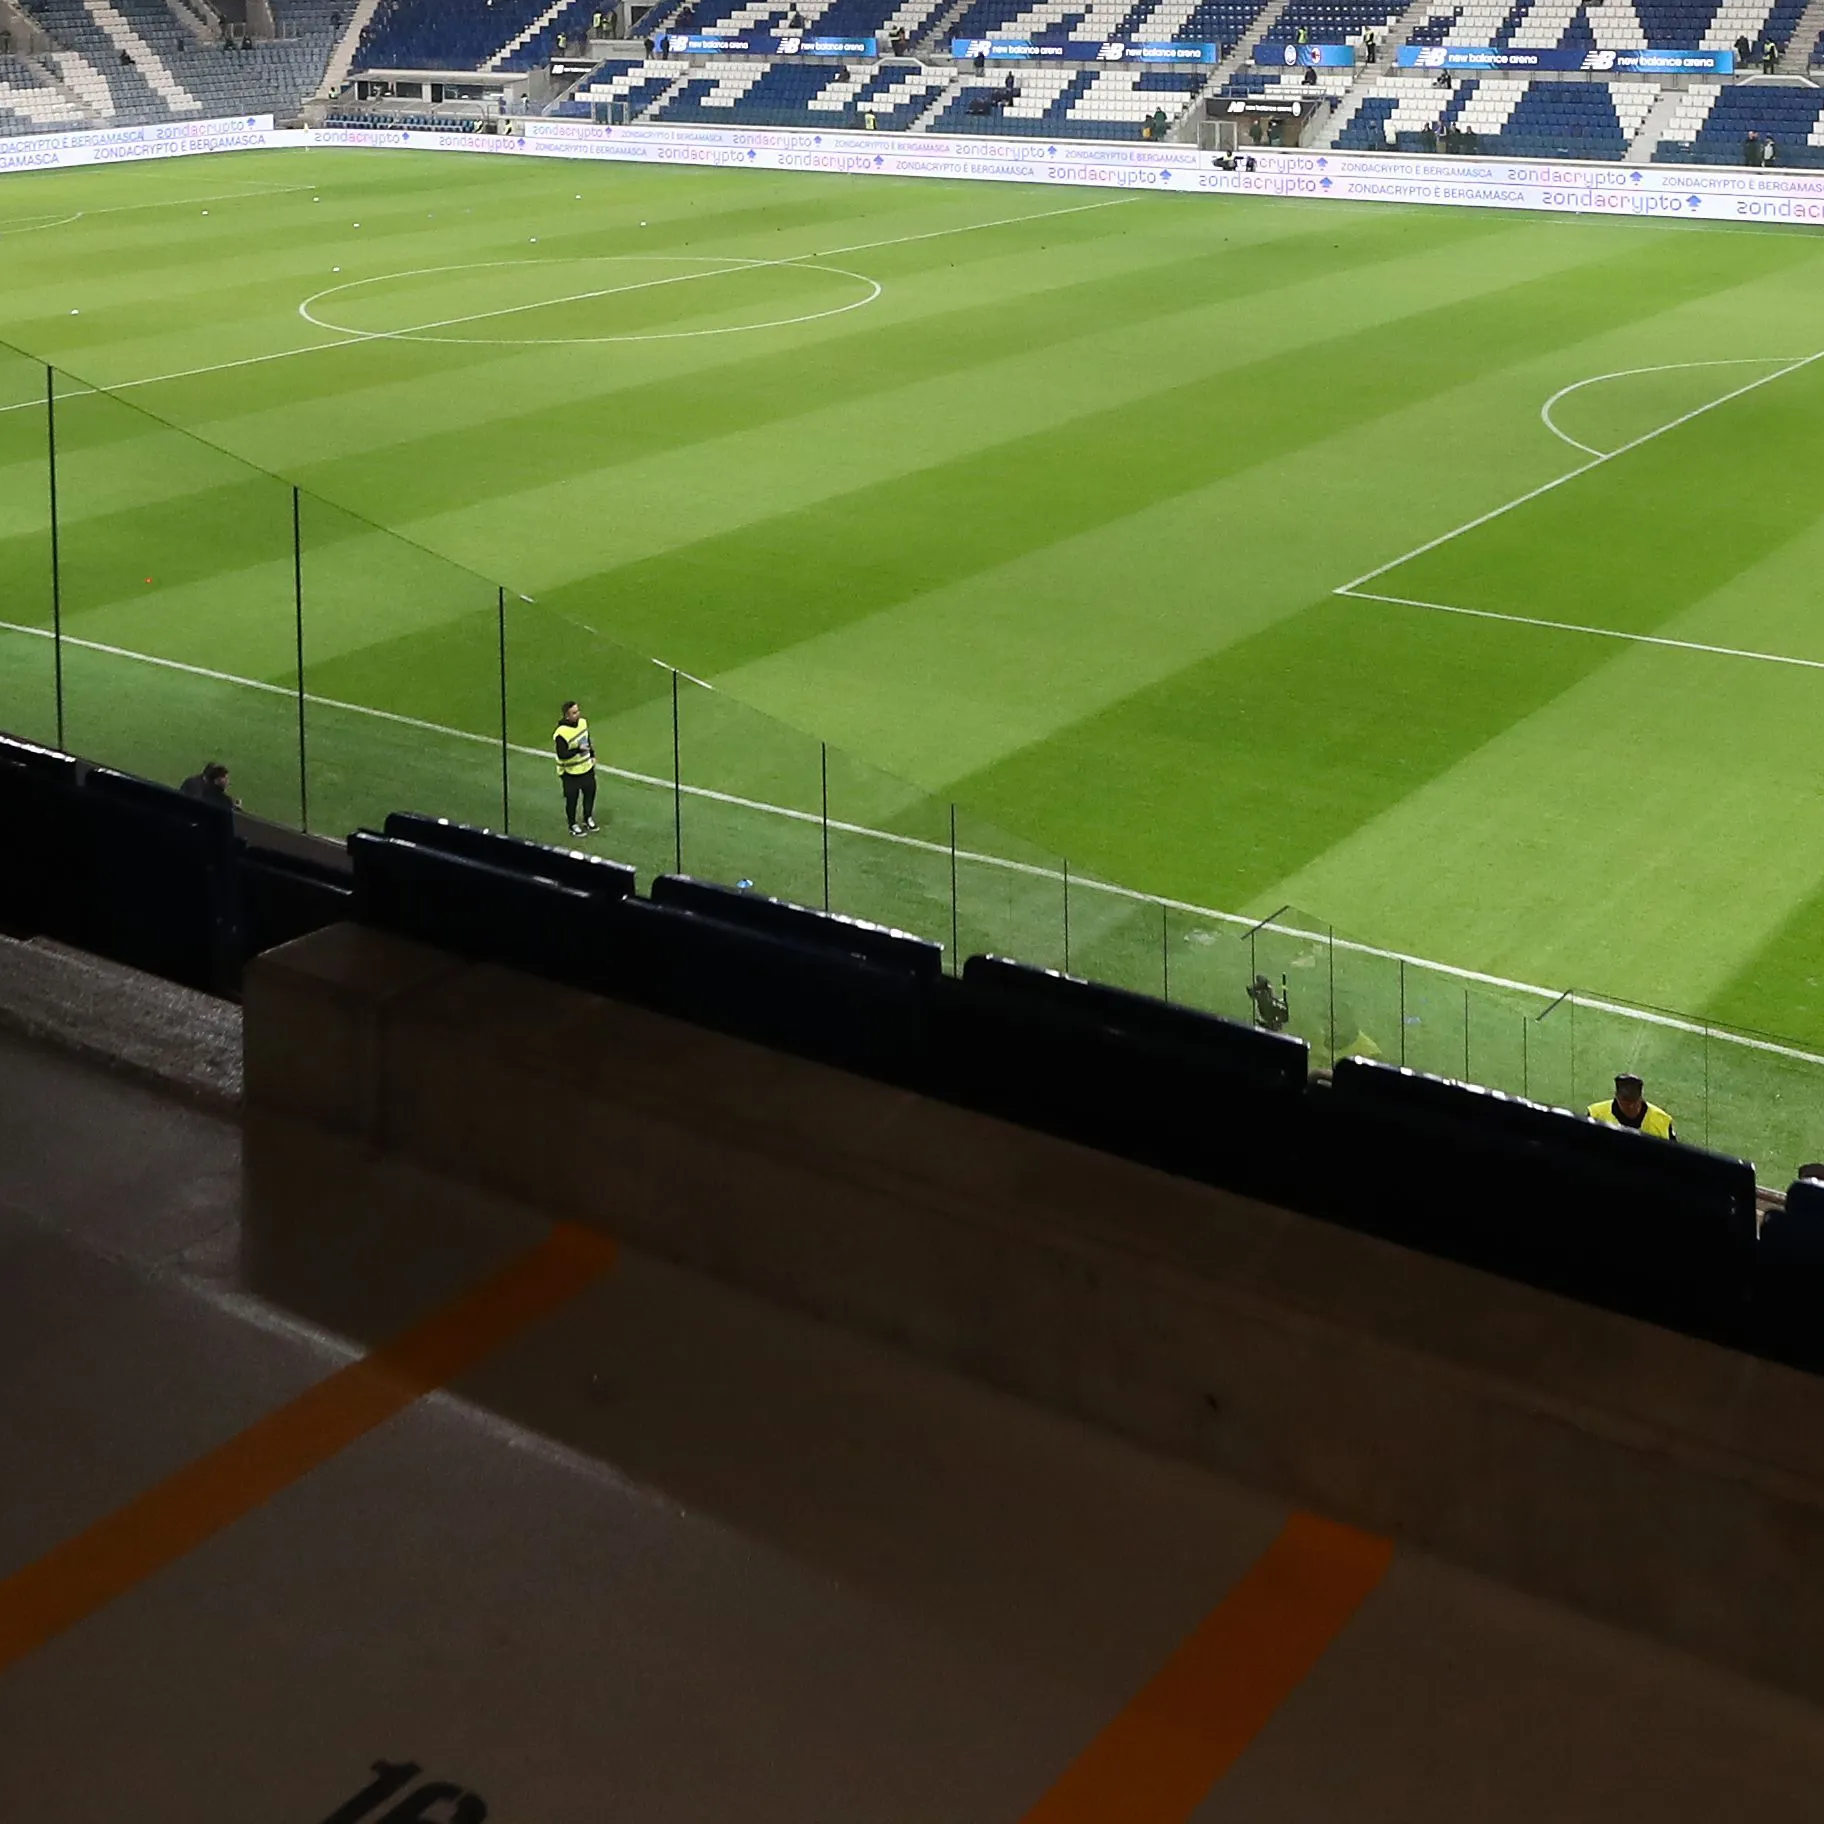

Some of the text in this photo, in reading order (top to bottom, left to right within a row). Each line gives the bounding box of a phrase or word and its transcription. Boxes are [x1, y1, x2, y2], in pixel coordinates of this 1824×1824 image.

[1448, 54, 1468, 63] new
[1469, 53, 1508, 64] balance
[1509, 55, 1538, 65] arena
[1617, 57, 1638, 66] new
[1640, 56, 1681, 67] balance
[1683, 58, 1714, 68] arena
[657, 146, 745, 165] zondacrypto
[955, 142, 1045, 161] zondacrypto
[778, 152, 871, 173] zondacrypto
[1047, 164, 1157, 186] zondacrypto
[1507, 167, 1626, 188] zondacrypto
[1662, 176, 1746, 190] ZONDACRYPTO
[1199, 175, 1316, 196] zondacrypto
[1348, 182, 1432, 197] ZONDACRYPTO
[1442, 187, 1525, 202] BERGAMASCA
[1542, 190, 1682, 214] zondacrypto
